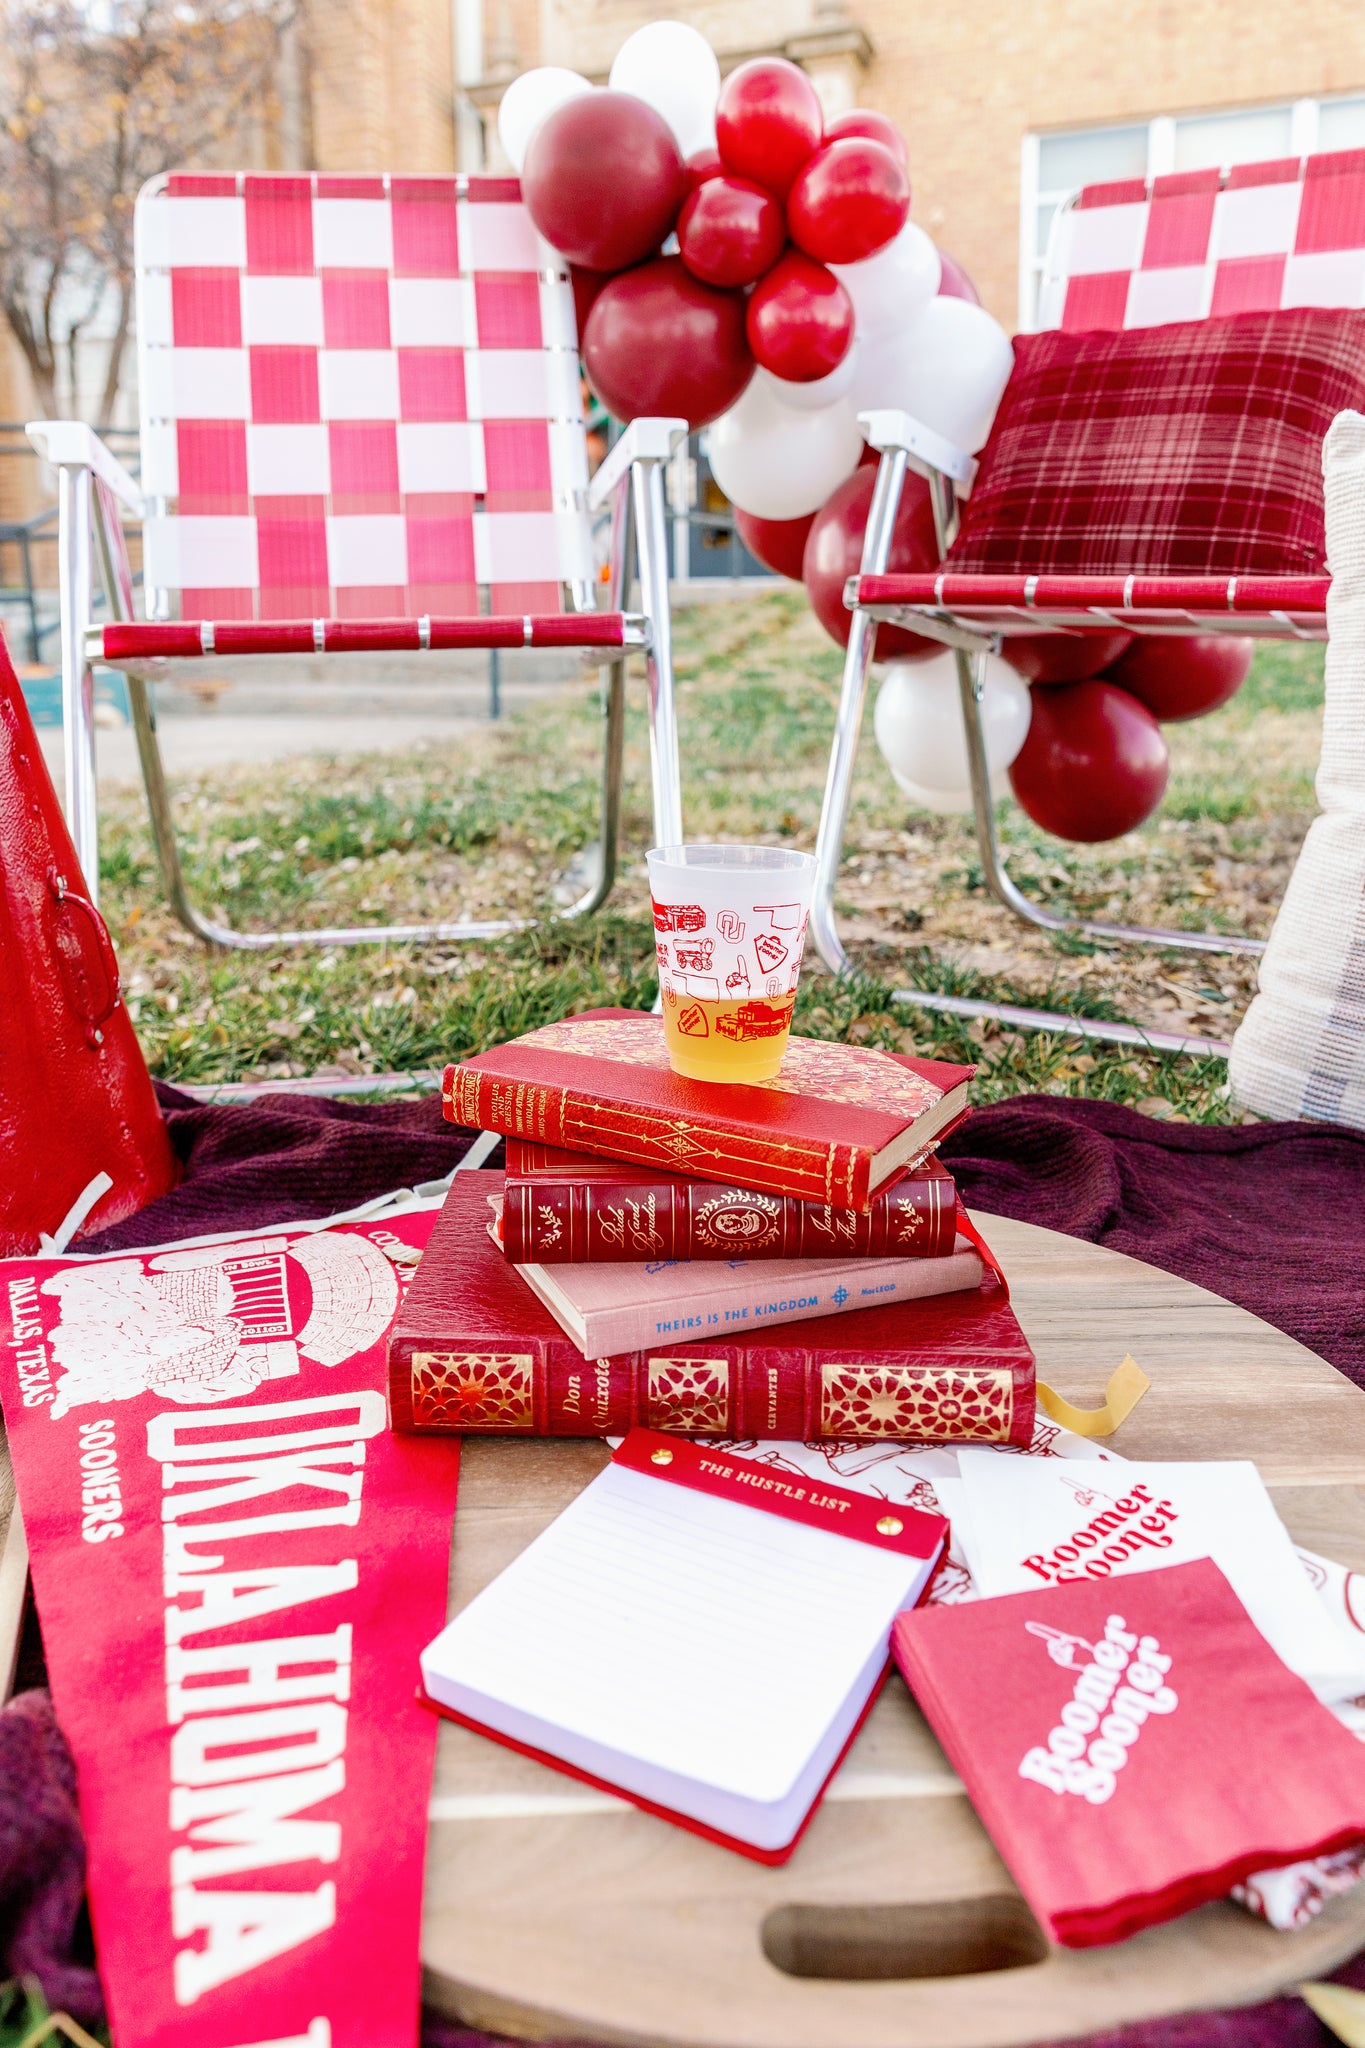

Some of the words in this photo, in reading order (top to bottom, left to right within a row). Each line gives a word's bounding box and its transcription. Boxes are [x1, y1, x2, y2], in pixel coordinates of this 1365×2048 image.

[465, 1073, 477, 1123] SHAKESPEARE
[505, 1085, 513, 1127] CRESSIDA
[597, 1205, 624, 1248] Pride
[625, 1198, 640, 1230] and
[628, 1192, 664, 1255] Prejudice
[810, 1204, 836, 1243] Jane
[836, 1209, 856, 1249] Aust
[368, 1230, 418, 1282] COON
[7, 1277, 43, 1347] DALLAS,
[656, 1317, 702, 1333] THEIRS
[707, 1314, 719, 1325] IS
[725, 1308, 749, 1321] THE
[755, 1296, 819, 1316] KINGDOM
[15, 1344, 54, 1408] TEXAS
[562, 1375, 581, 1415] Don
[590, 1358, 614, 1429] Quixote
[768, 1368, 778, 1430] CERVANTES
[78, 1419, 124, 1543] SOONERS
[699, 1460, 734, 1479] THE
[736, 1471, 806, 1501] HUSTLE
[809, 1493, 851, 1513] LIST
[1020, 1484, 1153, 1582] Boomer
[146, 1389, 387, 2007] OKLAHOMA
[1018, 1614, 1138, 1795] Boomer
[1063, 1635, 1179, 1805] Sooner
